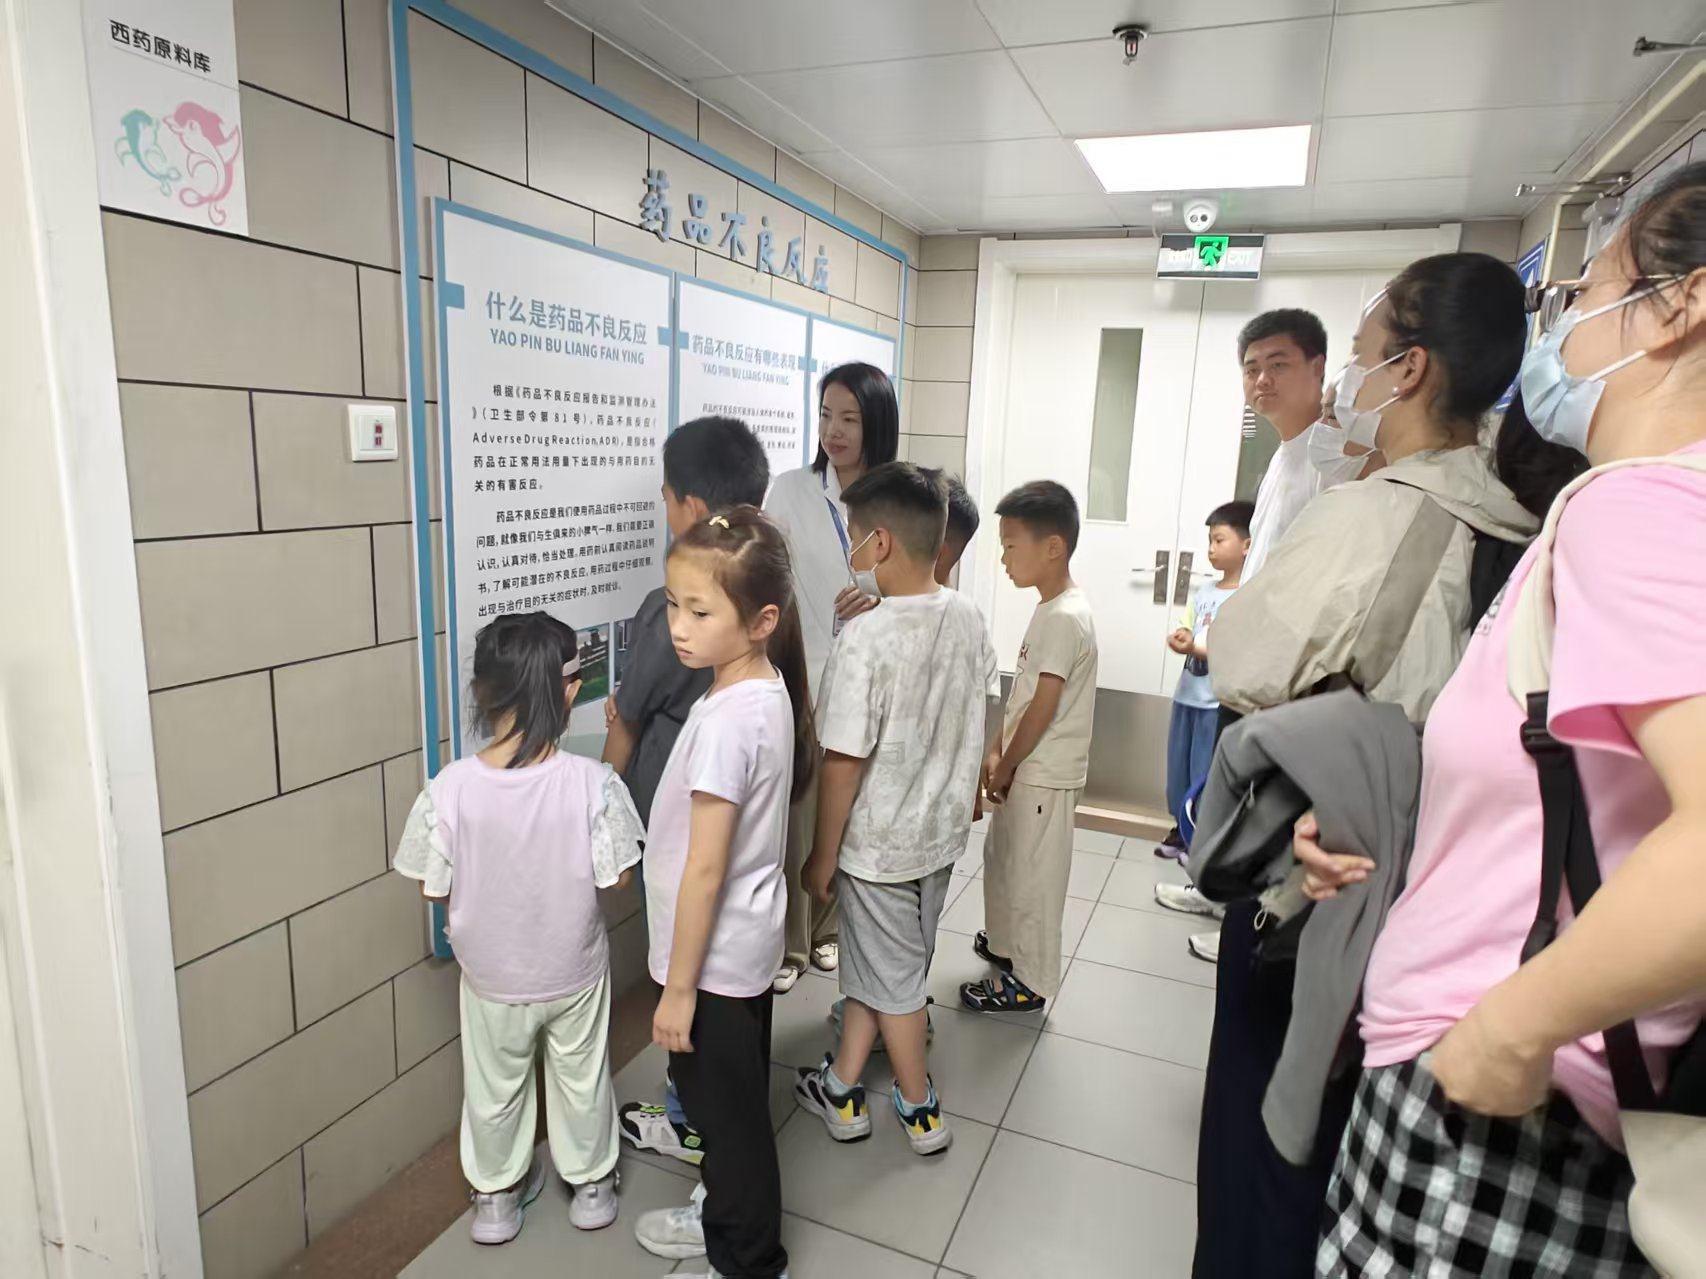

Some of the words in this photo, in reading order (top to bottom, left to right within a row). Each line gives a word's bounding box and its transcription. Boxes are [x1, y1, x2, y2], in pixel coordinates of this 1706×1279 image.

[110, 20, 210, 72] 西药原料库
[639, 169, 829, 294] 药品不良反应
[487, 291, 647, 344] 什么是药品不良反应
[491, 328, 517, 346] YAO
[521, 332, 543, 351] PIN
[546, 336, 562, 352] BU
[565, 340, 598, 359] LIANG
[600, 347, 620, 362] FAN
[621, 350, 645, 365] YING
[692, 334, 796, 371] 药品不良反应有哪些表现
